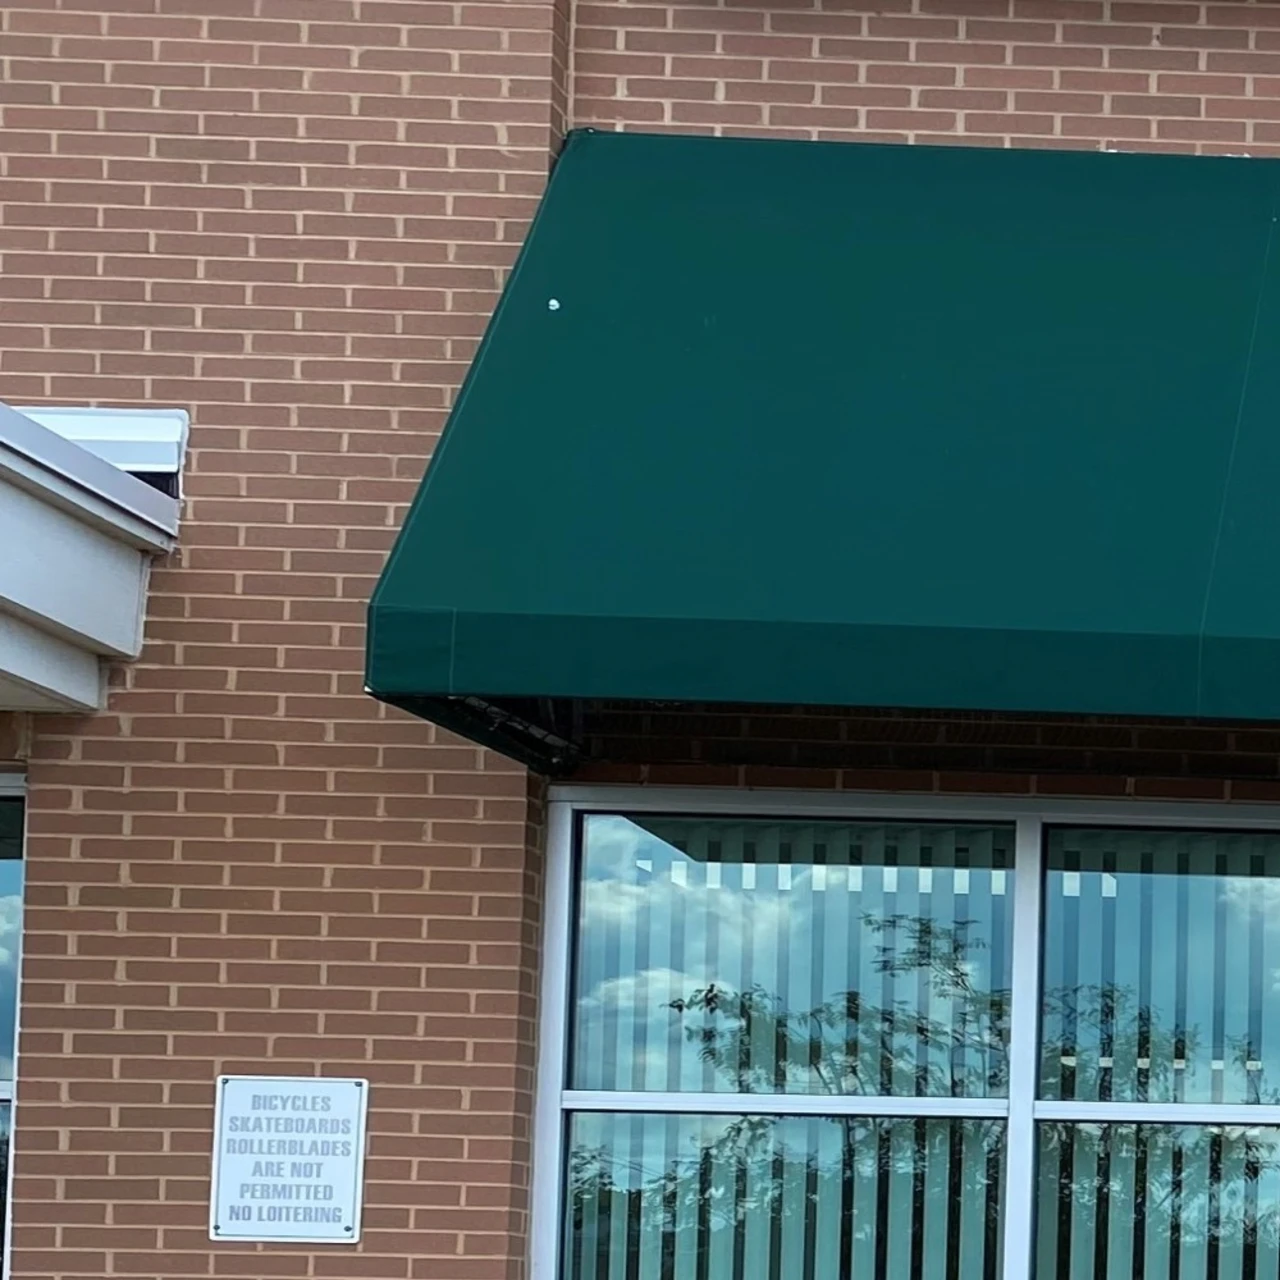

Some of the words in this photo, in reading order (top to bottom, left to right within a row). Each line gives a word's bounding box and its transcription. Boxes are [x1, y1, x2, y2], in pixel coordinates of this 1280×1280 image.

[251, 1094, 331, 1112] BICYCLES
[228, 1116, 351, 1135] SKATEBOARDS
[226, 1138, 352, 1156] ROLLERBLADES
[251, 1161, 285, 1178] ARE
[290, 1162, 324, 1179] NOT
[239, 1183, 334, 1201] PERMITTED
[228, 1205, 252, 1221] NO
[257, 1206, 342, 1223] LOITERING
